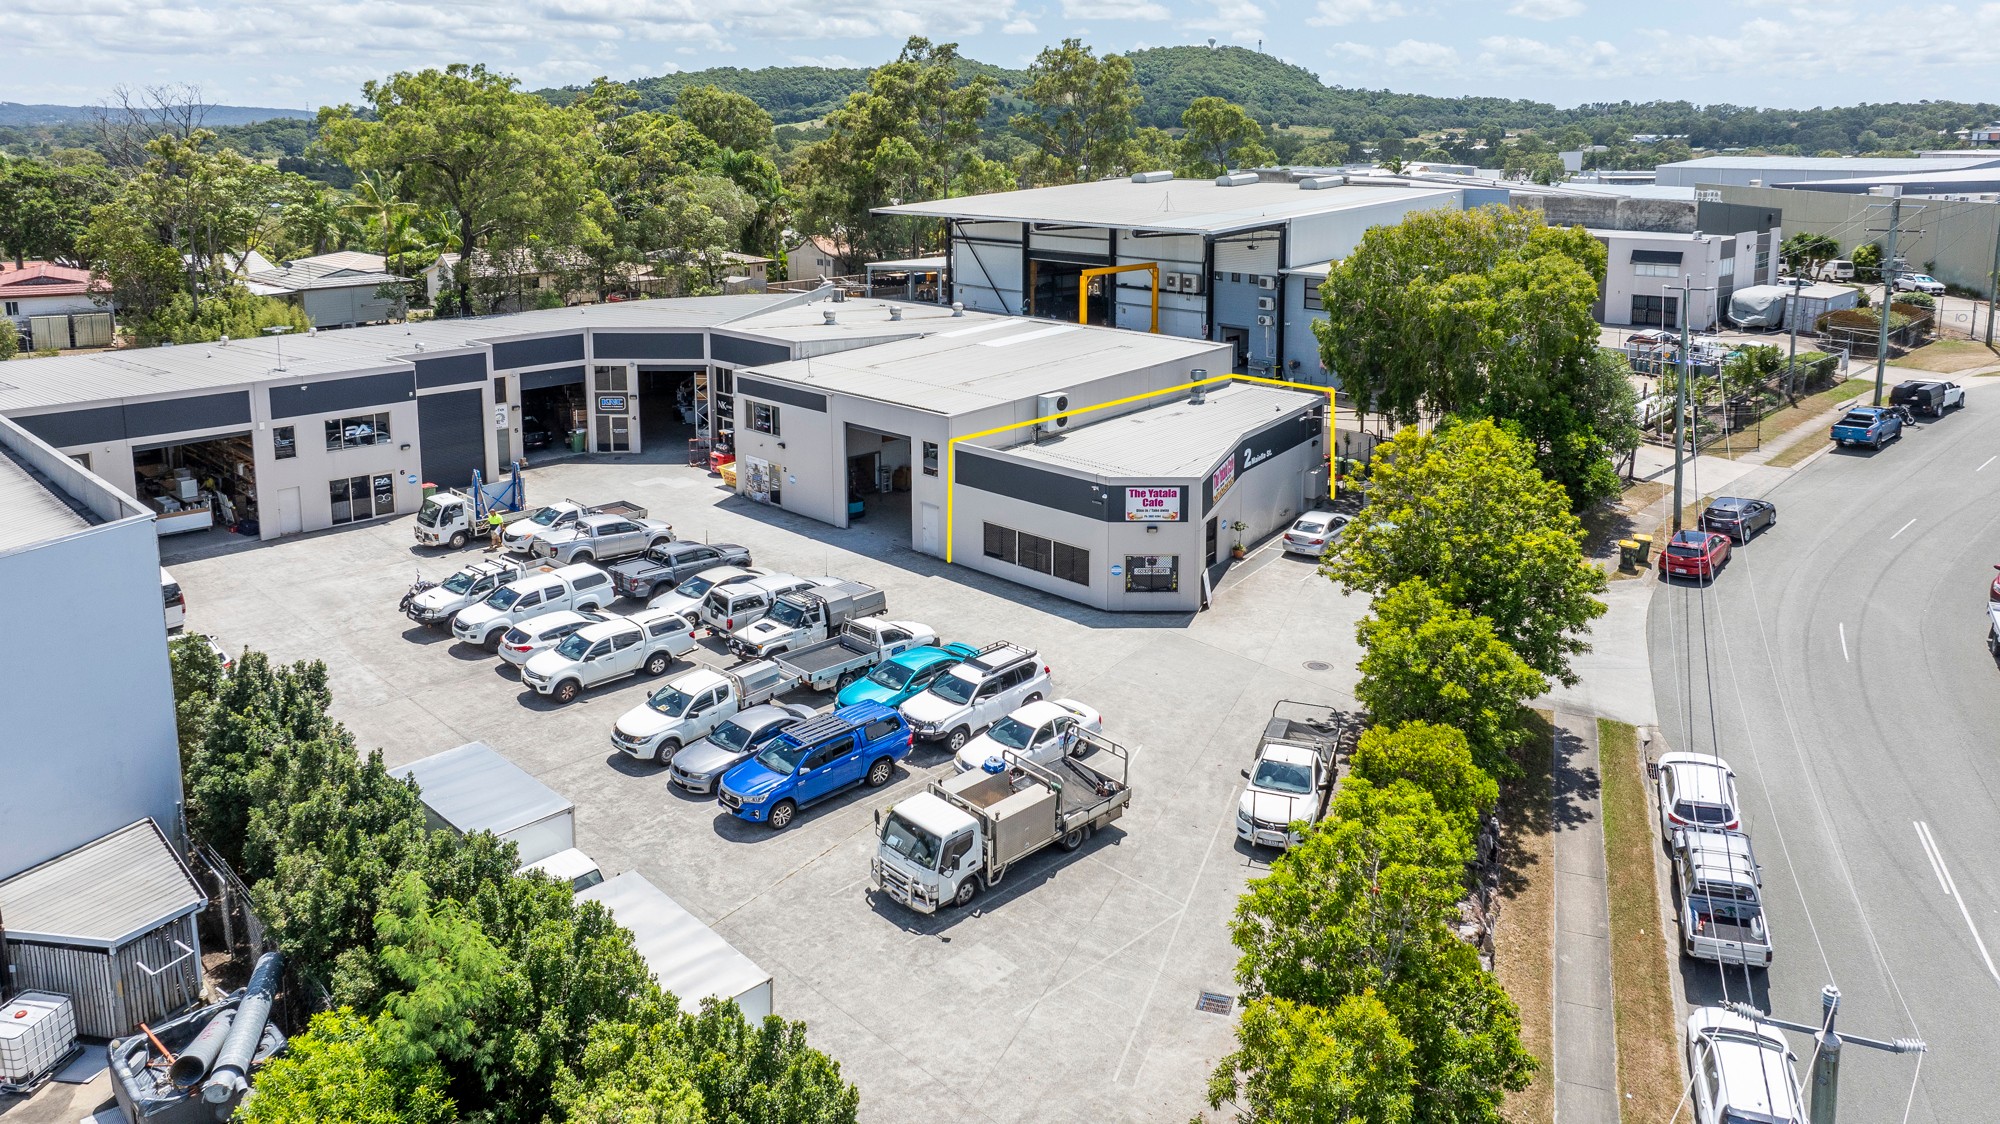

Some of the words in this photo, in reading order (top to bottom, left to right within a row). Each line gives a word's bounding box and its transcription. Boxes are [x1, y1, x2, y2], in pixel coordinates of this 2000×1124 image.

[1243, 448, 1252, 469] 2
[1129, 489, 1146, 498] The
[1148, 489, 1177, 498] Yatala
[1142, 498, 1164, 507] Cafe
